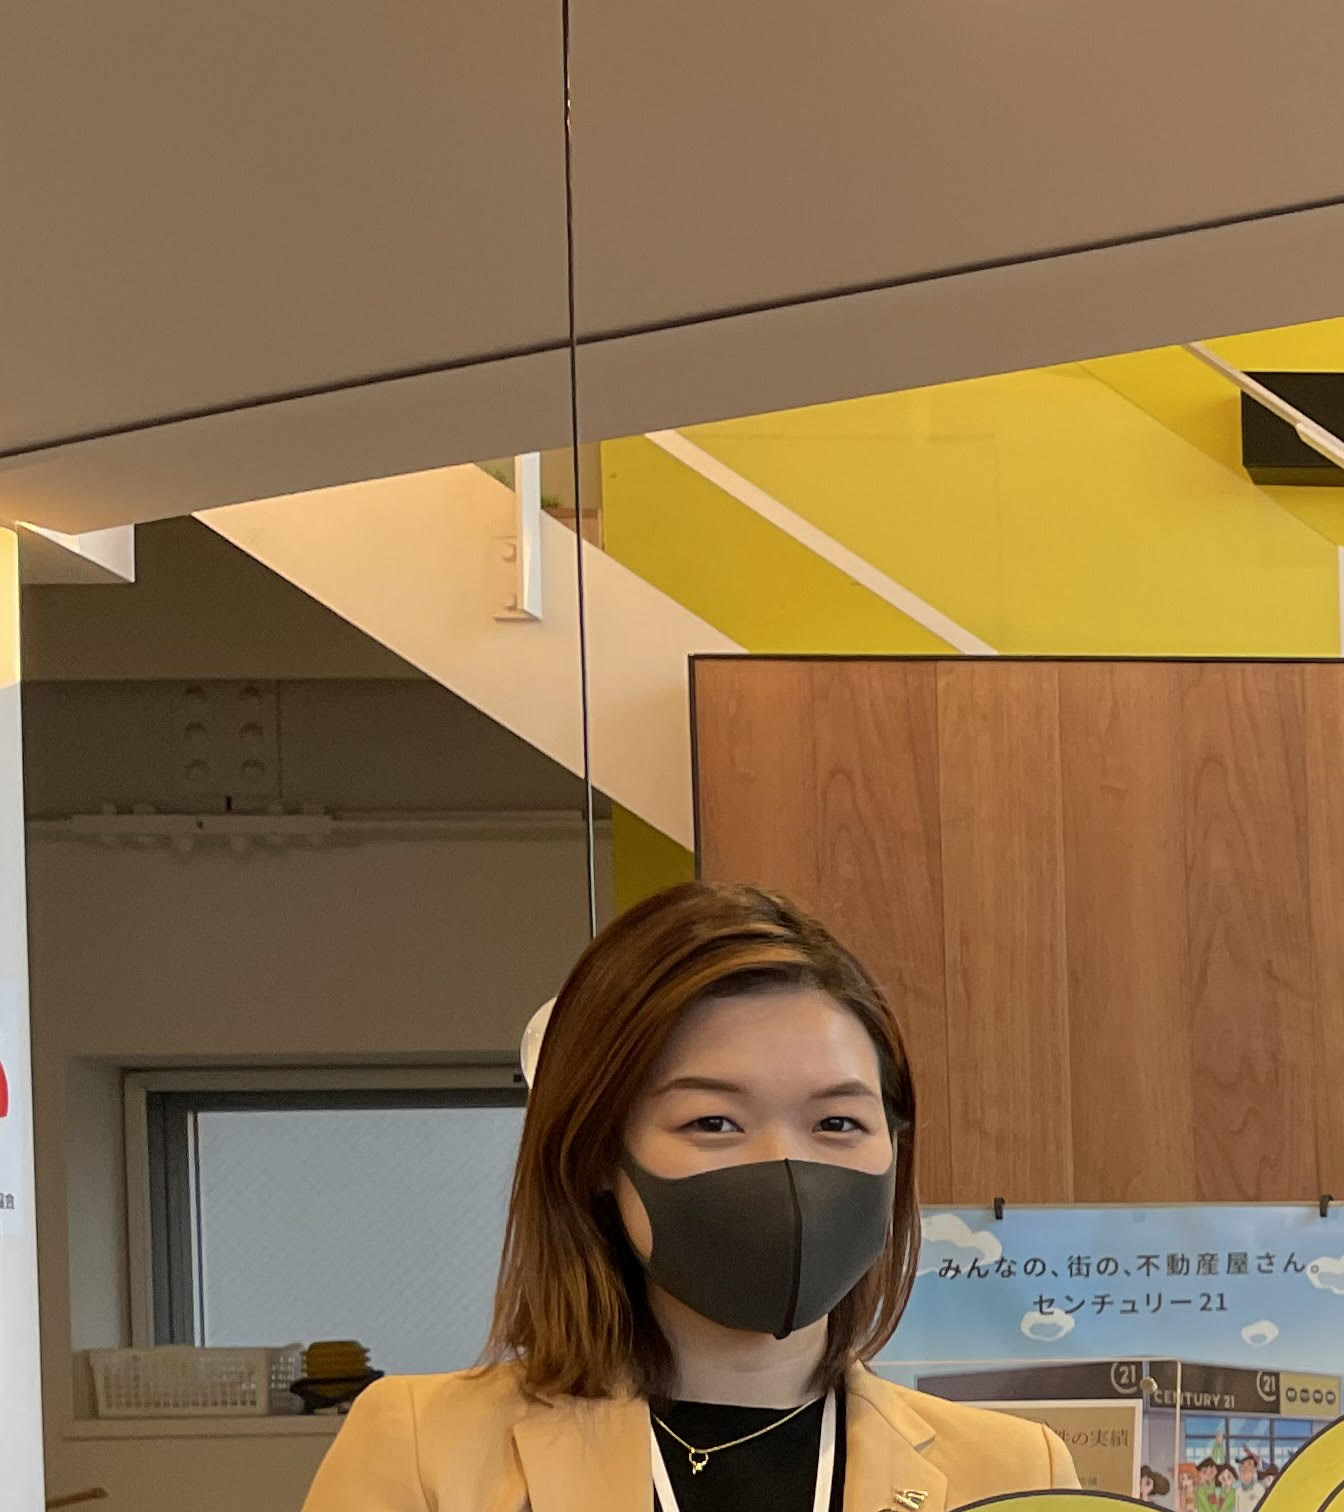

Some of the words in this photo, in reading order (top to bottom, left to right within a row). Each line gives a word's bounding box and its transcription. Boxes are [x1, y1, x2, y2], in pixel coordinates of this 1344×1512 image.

[937, 1251, 1320, 1281] みんなの、街の、不動産屋さん。
[1153, 1389, 1221, 1408] CENTURY
[1223, 1394, 1235, 1409] 21
